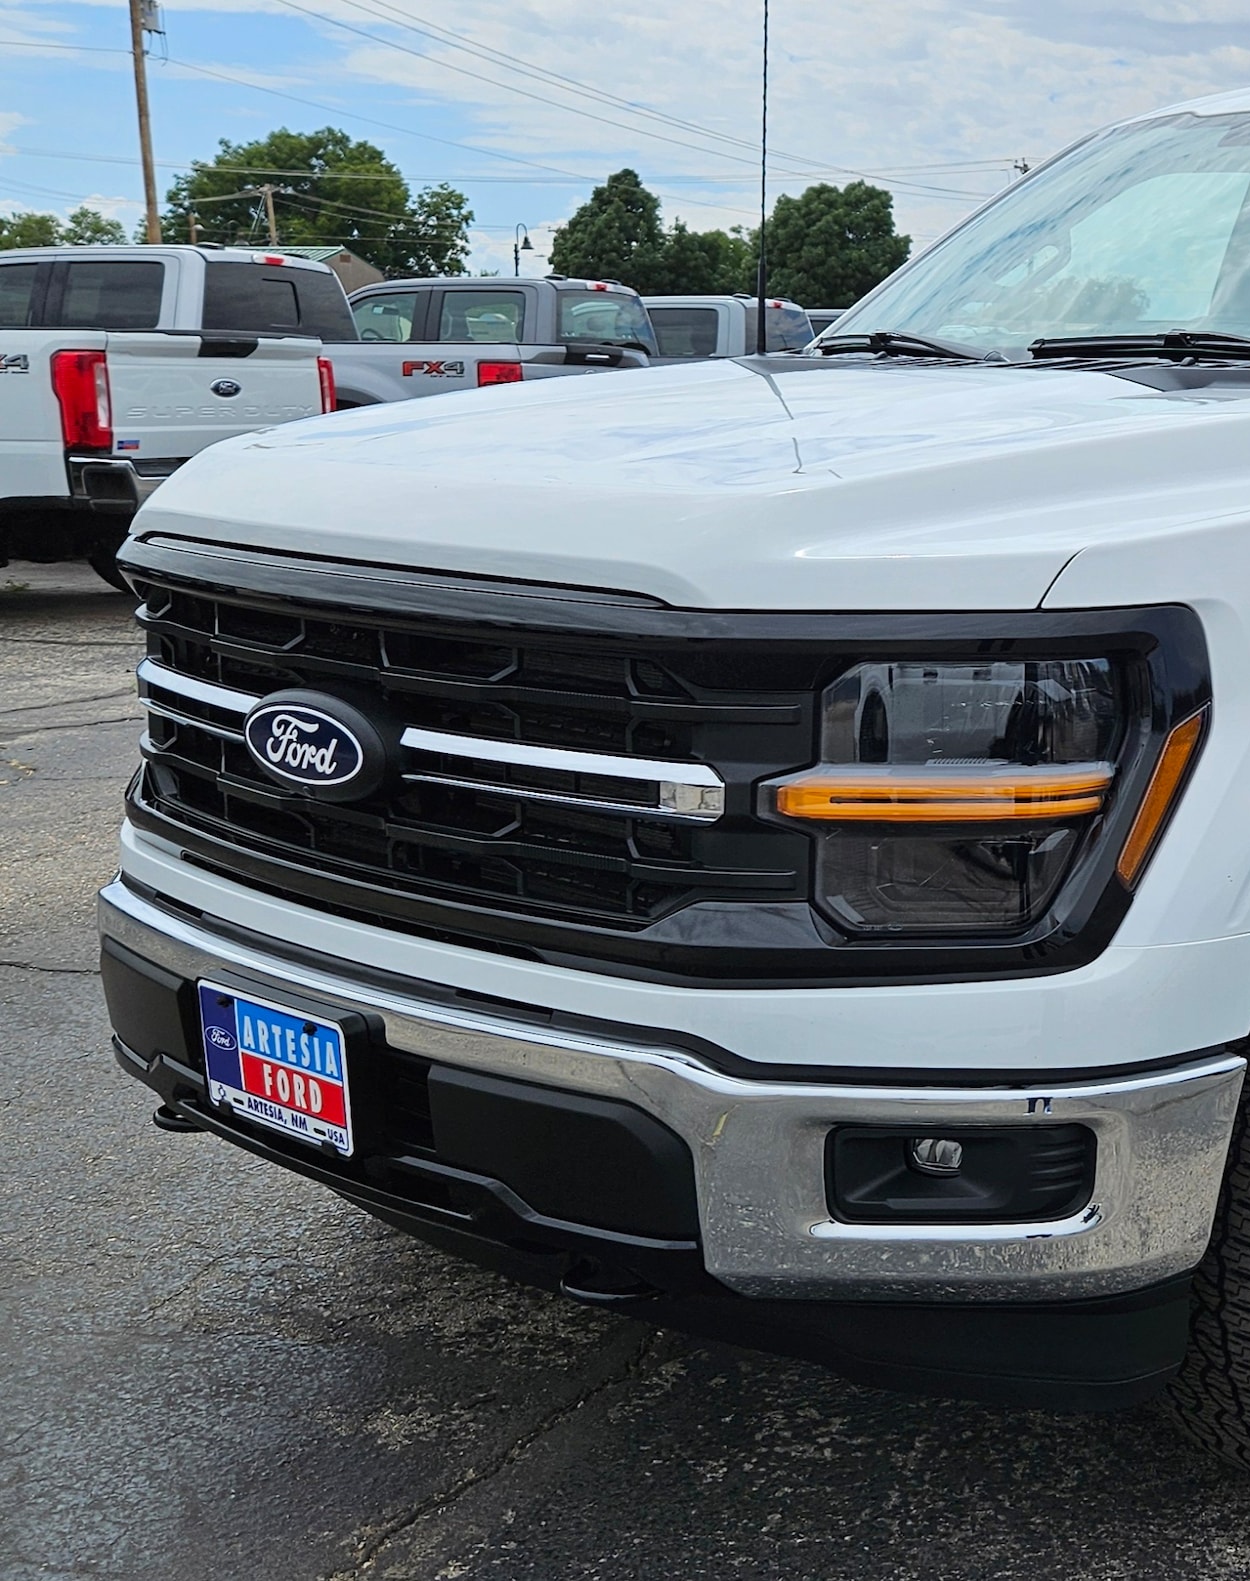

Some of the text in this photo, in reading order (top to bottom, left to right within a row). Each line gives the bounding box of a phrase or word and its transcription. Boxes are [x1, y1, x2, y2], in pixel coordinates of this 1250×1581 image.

[403, 361, 465, 376] FX4
[127, 406, 236, 419] SUPER
[266, 713, 338, 775] Ford
[211, 1028, 231, 1047] Ford
[243, 1015, 338, 1077] ARTESIA
[263, 1063, 323, 1114] FORD
[247, 1097, 345, 1145] ARTESIA, NM USA
